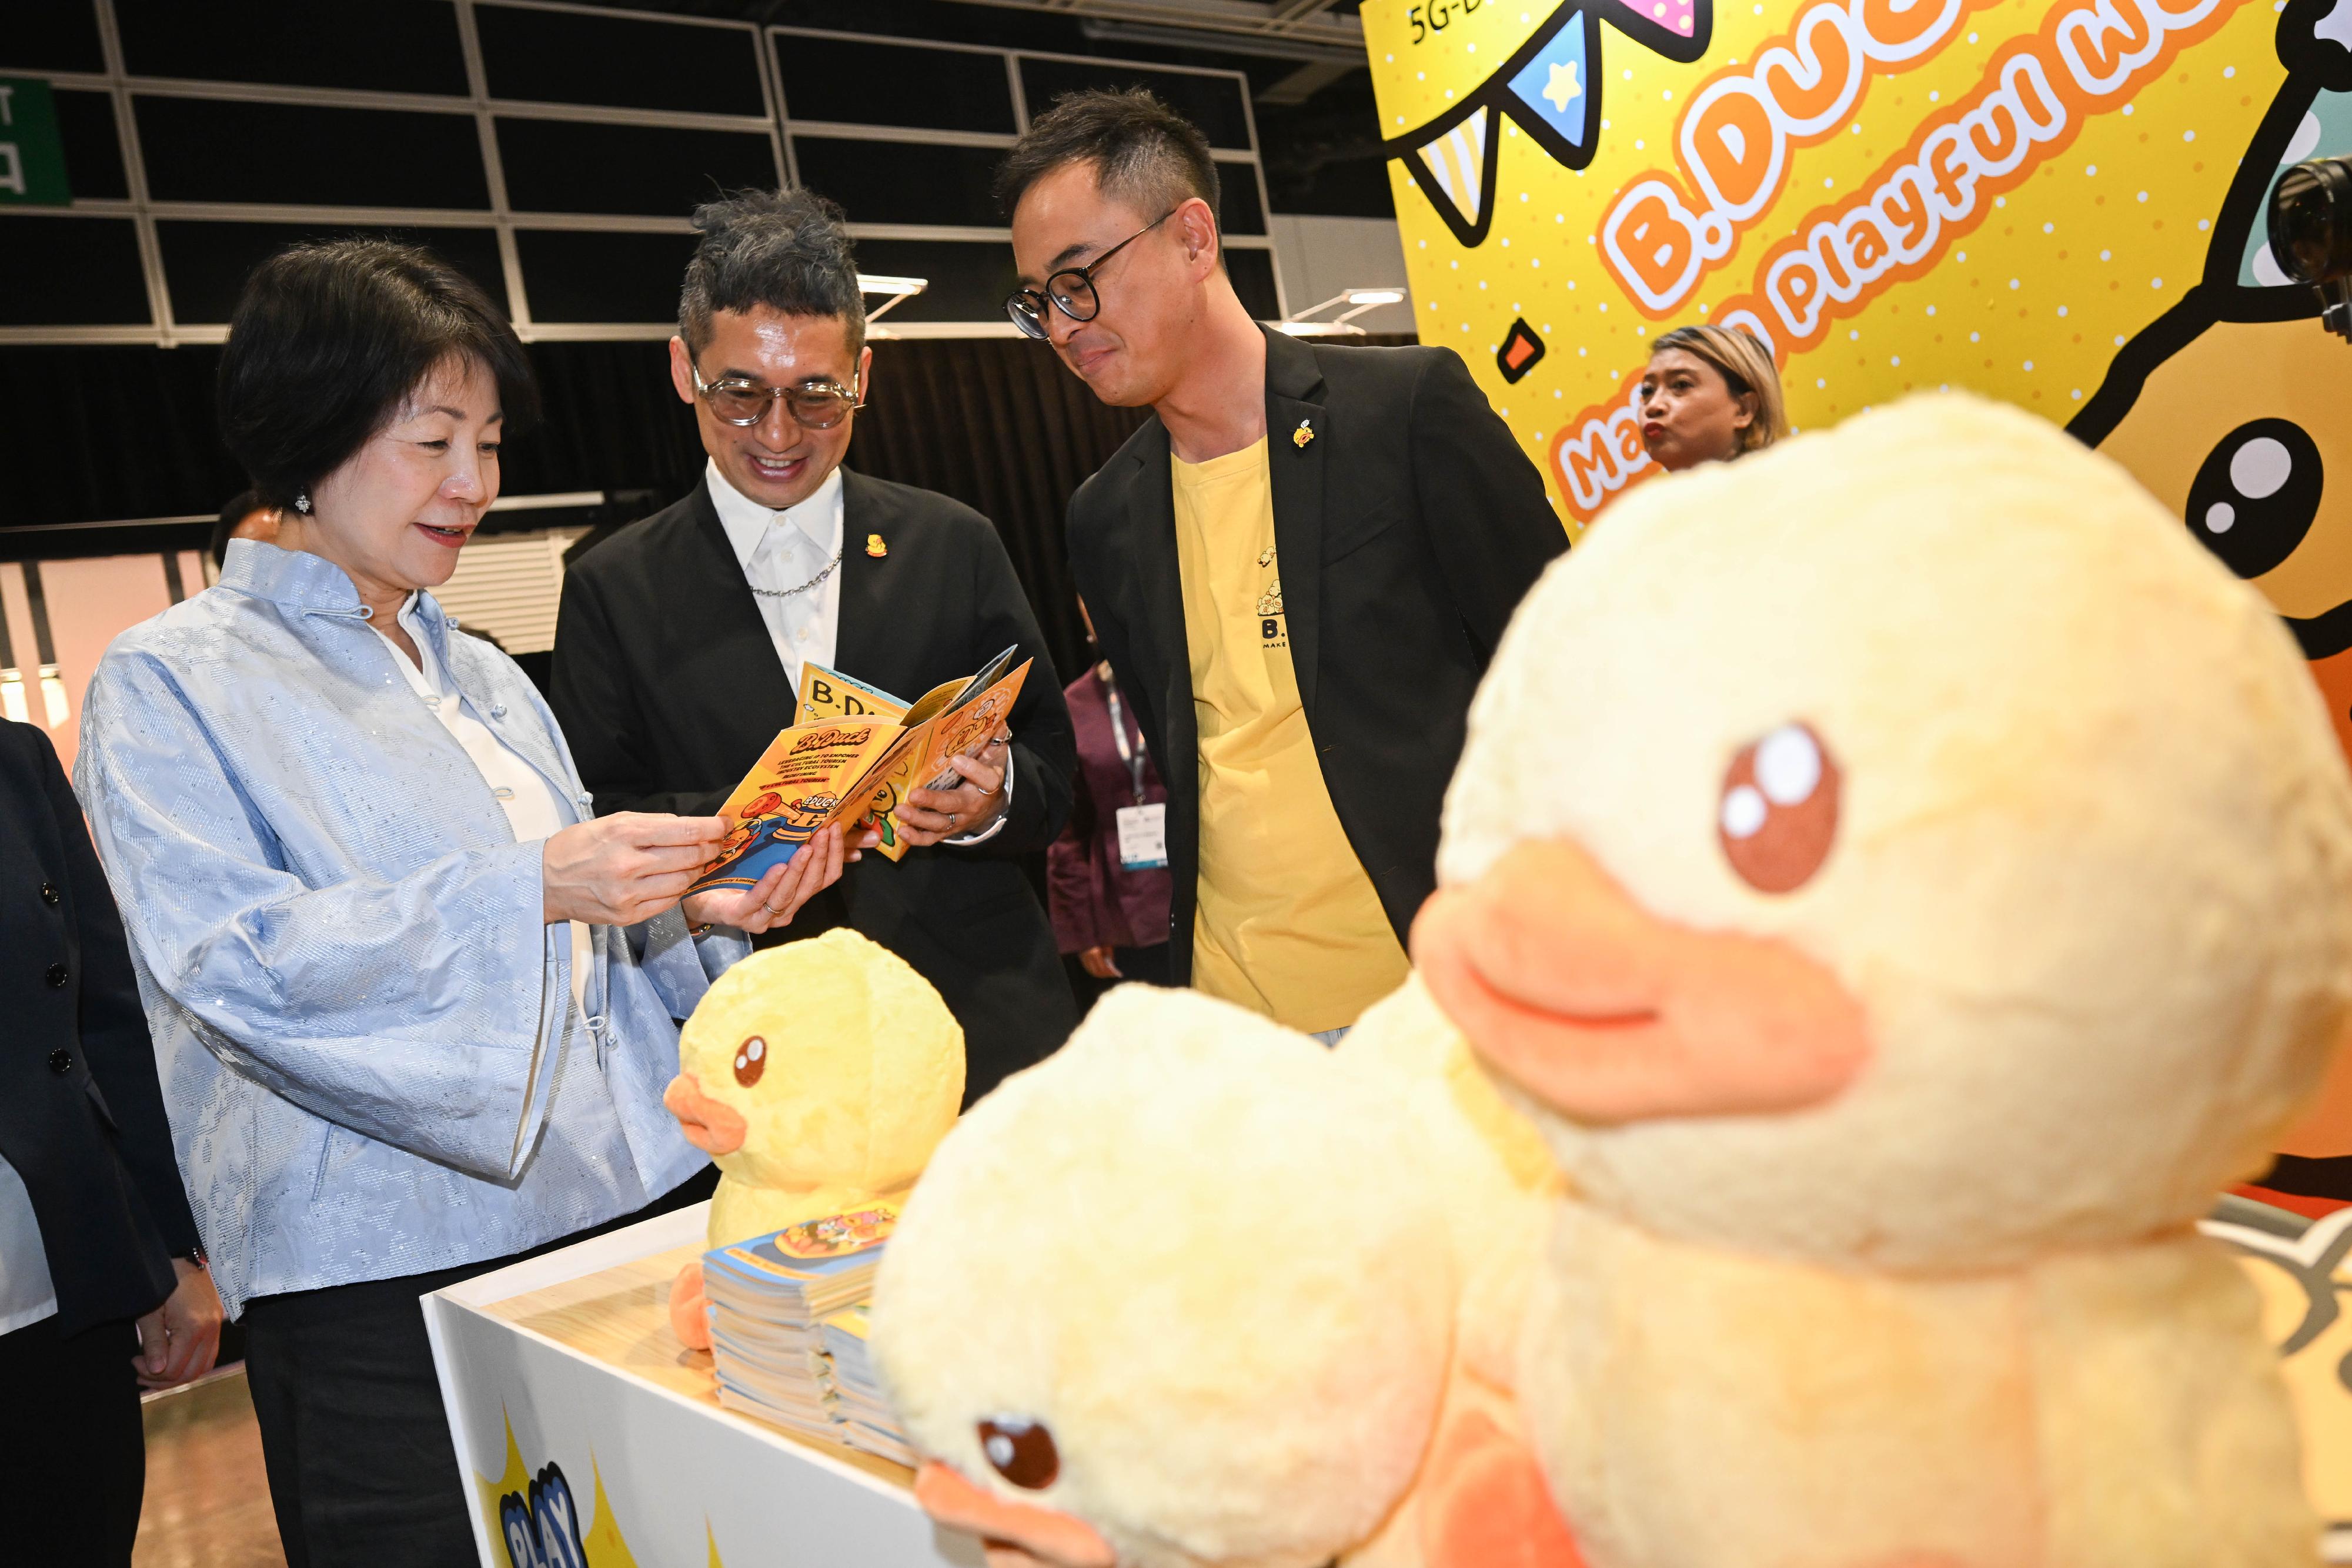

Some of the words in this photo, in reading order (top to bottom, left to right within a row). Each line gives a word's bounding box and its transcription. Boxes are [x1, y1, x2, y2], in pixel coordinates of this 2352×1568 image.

[1766, 53, 2067, 338] Playful
[789, 728, 871, 756] B.Duck
[778, 755, 813, 765] LEVERAGING
[776, 767, 803, 775] INDUSTRY
